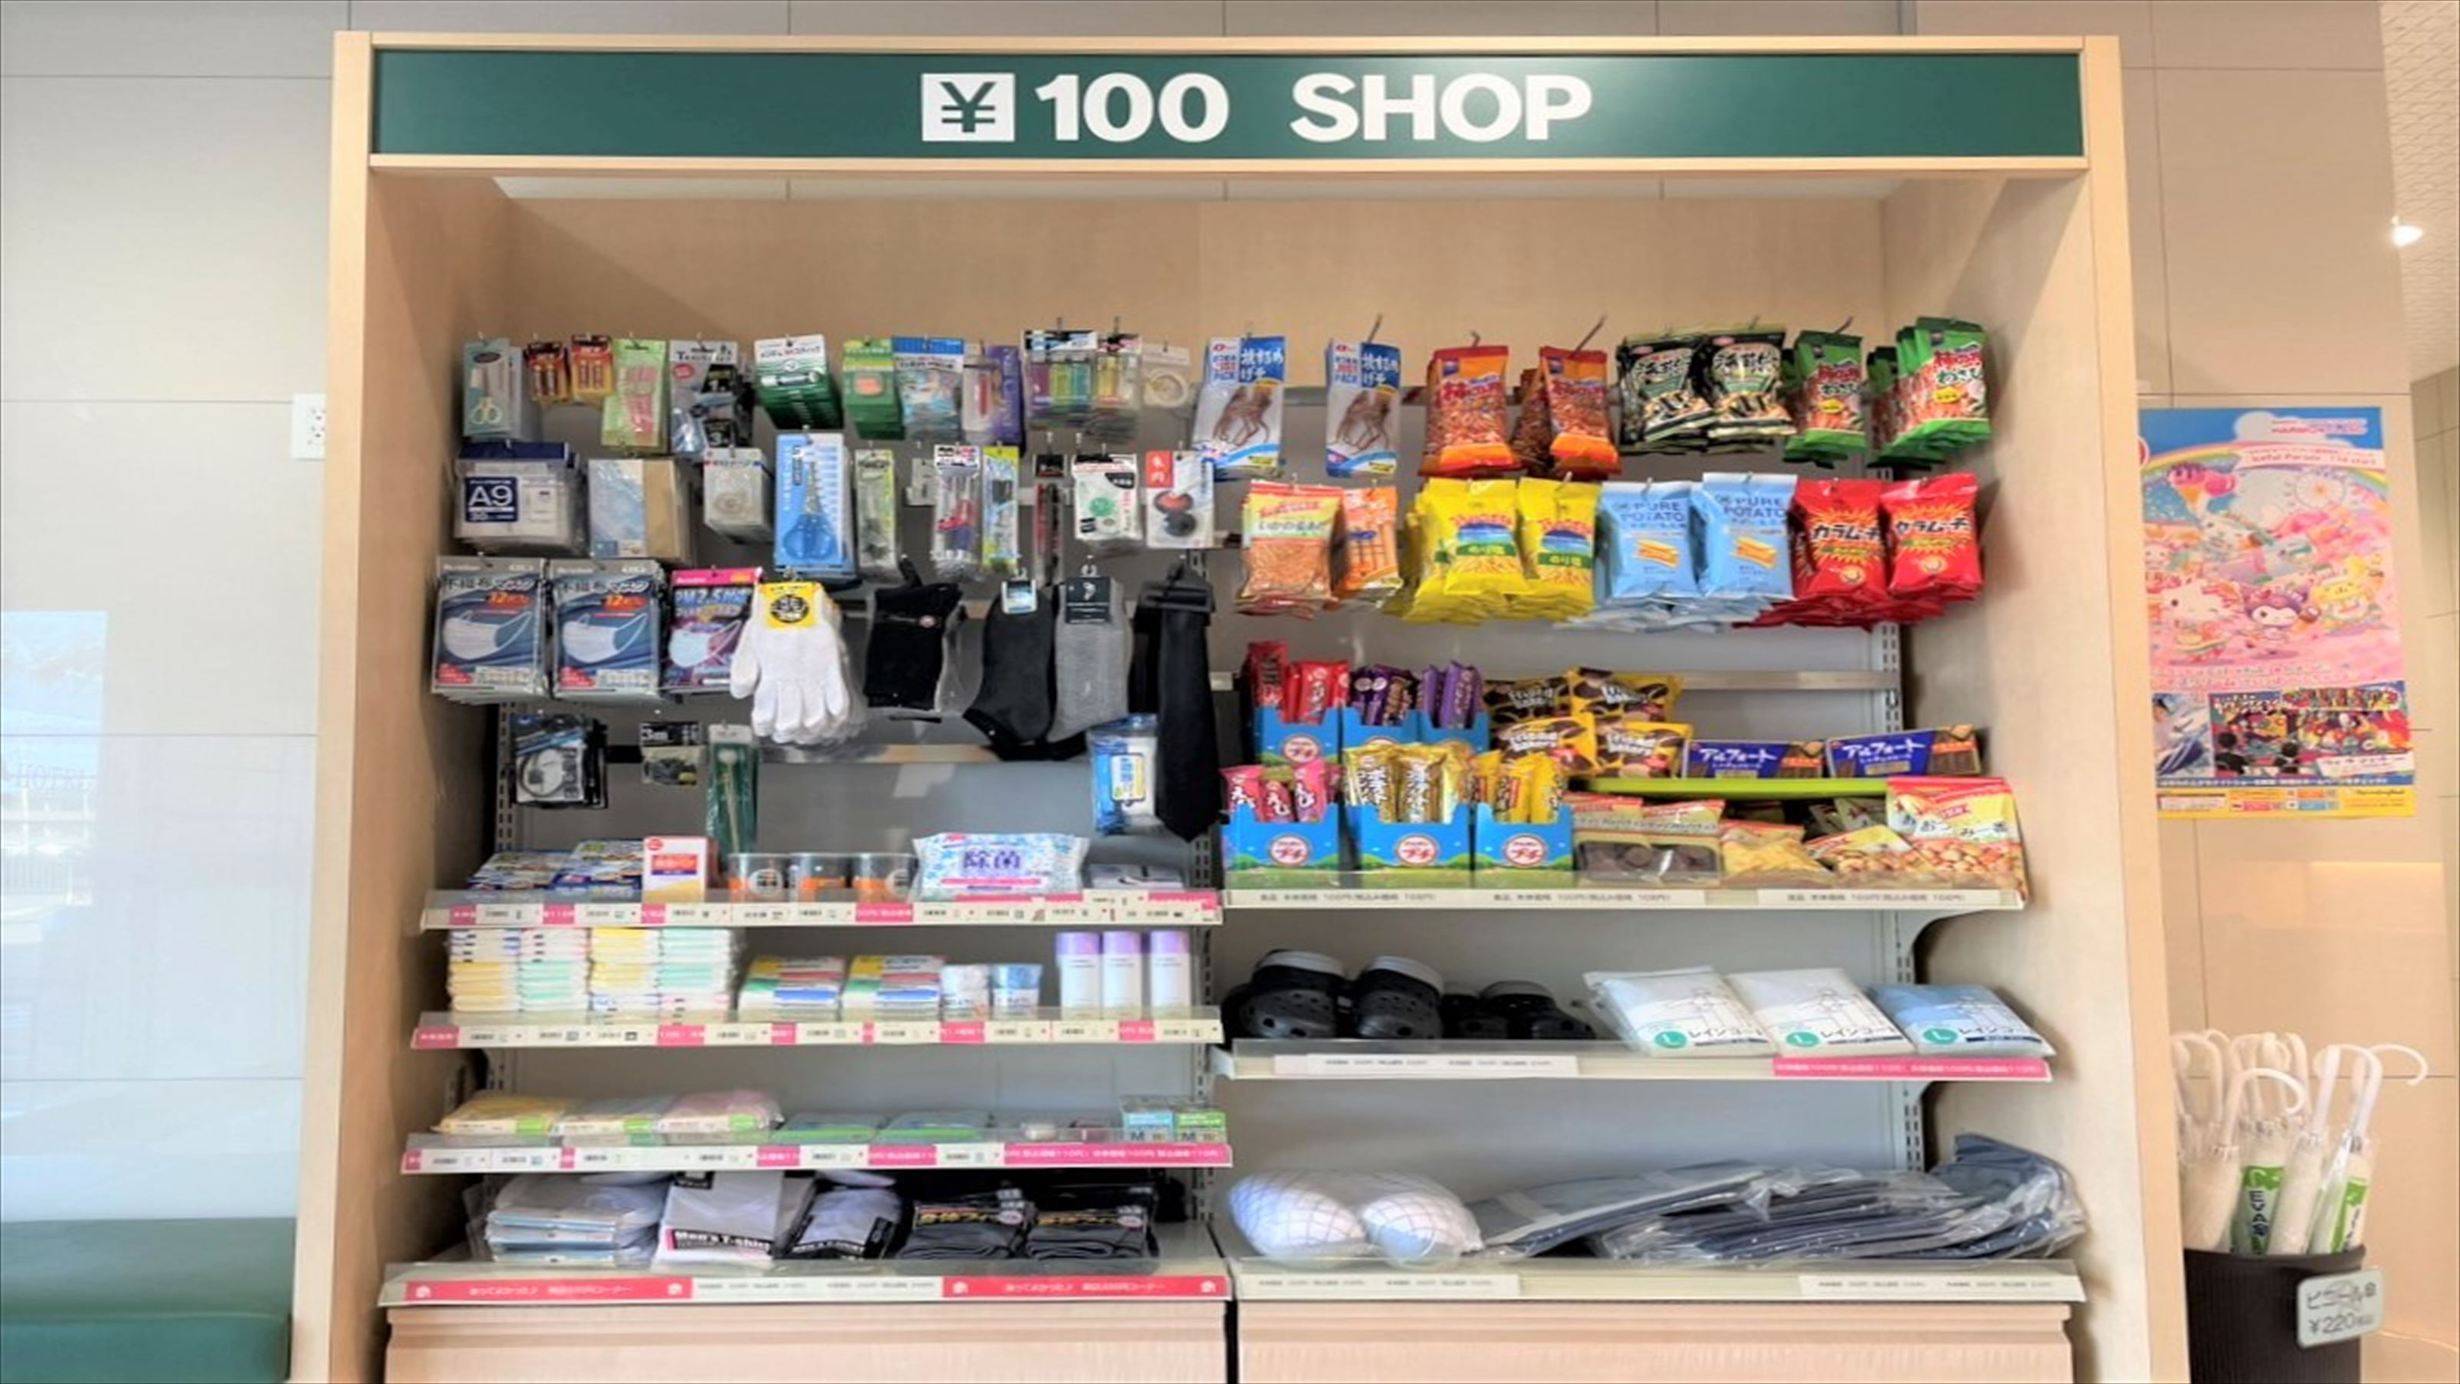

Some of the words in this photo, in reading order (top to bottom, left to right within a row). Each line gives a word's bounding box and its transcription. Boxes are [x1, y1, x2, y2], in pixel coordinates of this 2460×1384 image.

[1289, 72, 1594, 143] SHOP
[468, 484, 514, 508] A9
[1736, 497, 1782, 507] PURE
[1634, 502, 1681, 513] PURE
[1815, 524, 1881, 540] カラムーチ
[1897, 518, 1968, 533] カラムーチ
[1700, 748, 1777, 762] アルフォート
[1842, 738, 1925, 760] アルフォート
[962, 850, 1022, 869] 除菌
